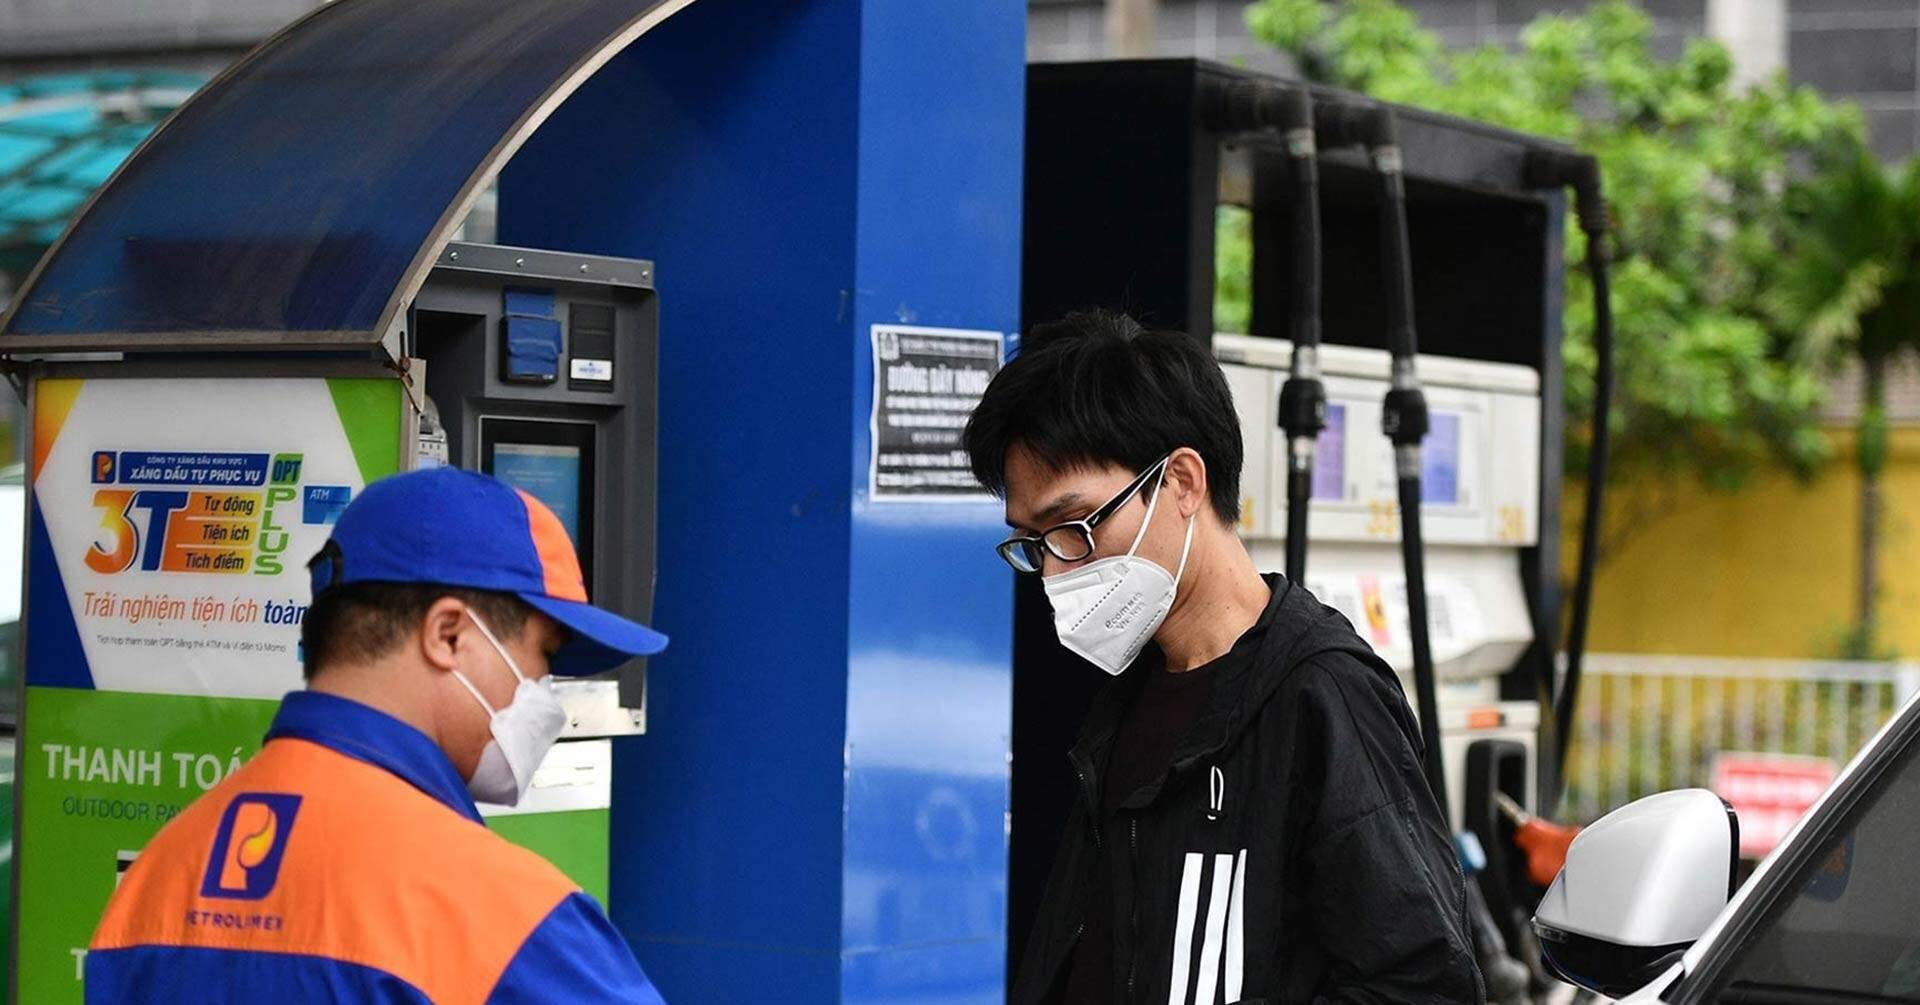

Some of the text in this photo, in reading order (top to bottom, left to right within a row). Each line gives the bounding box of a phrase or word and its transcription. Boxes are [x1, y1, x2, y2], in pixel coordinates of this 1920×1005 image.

[209, 469, 243, 485] PHỤC
[245, 470, 262, 485] VỤ
[272, 459, 302, 482] OPT
[205, 495, 255, 515] Tự động
[309, 488, 331, 501] ATM
[84, 489, 189, 575] 3T
[203, 524, 250, 545] Tiện ích
[253, 487, 297, 576] PLUS
[84, 591, 117, 617] Trải
[119, 593, 186, 627] nghiệm
[191, 594, 225, 629] tiện
[230, 596, 258, 623] ích
[42, 743, 162, 787] THANH
[62, 795, 150, 821] OUTDOOR
